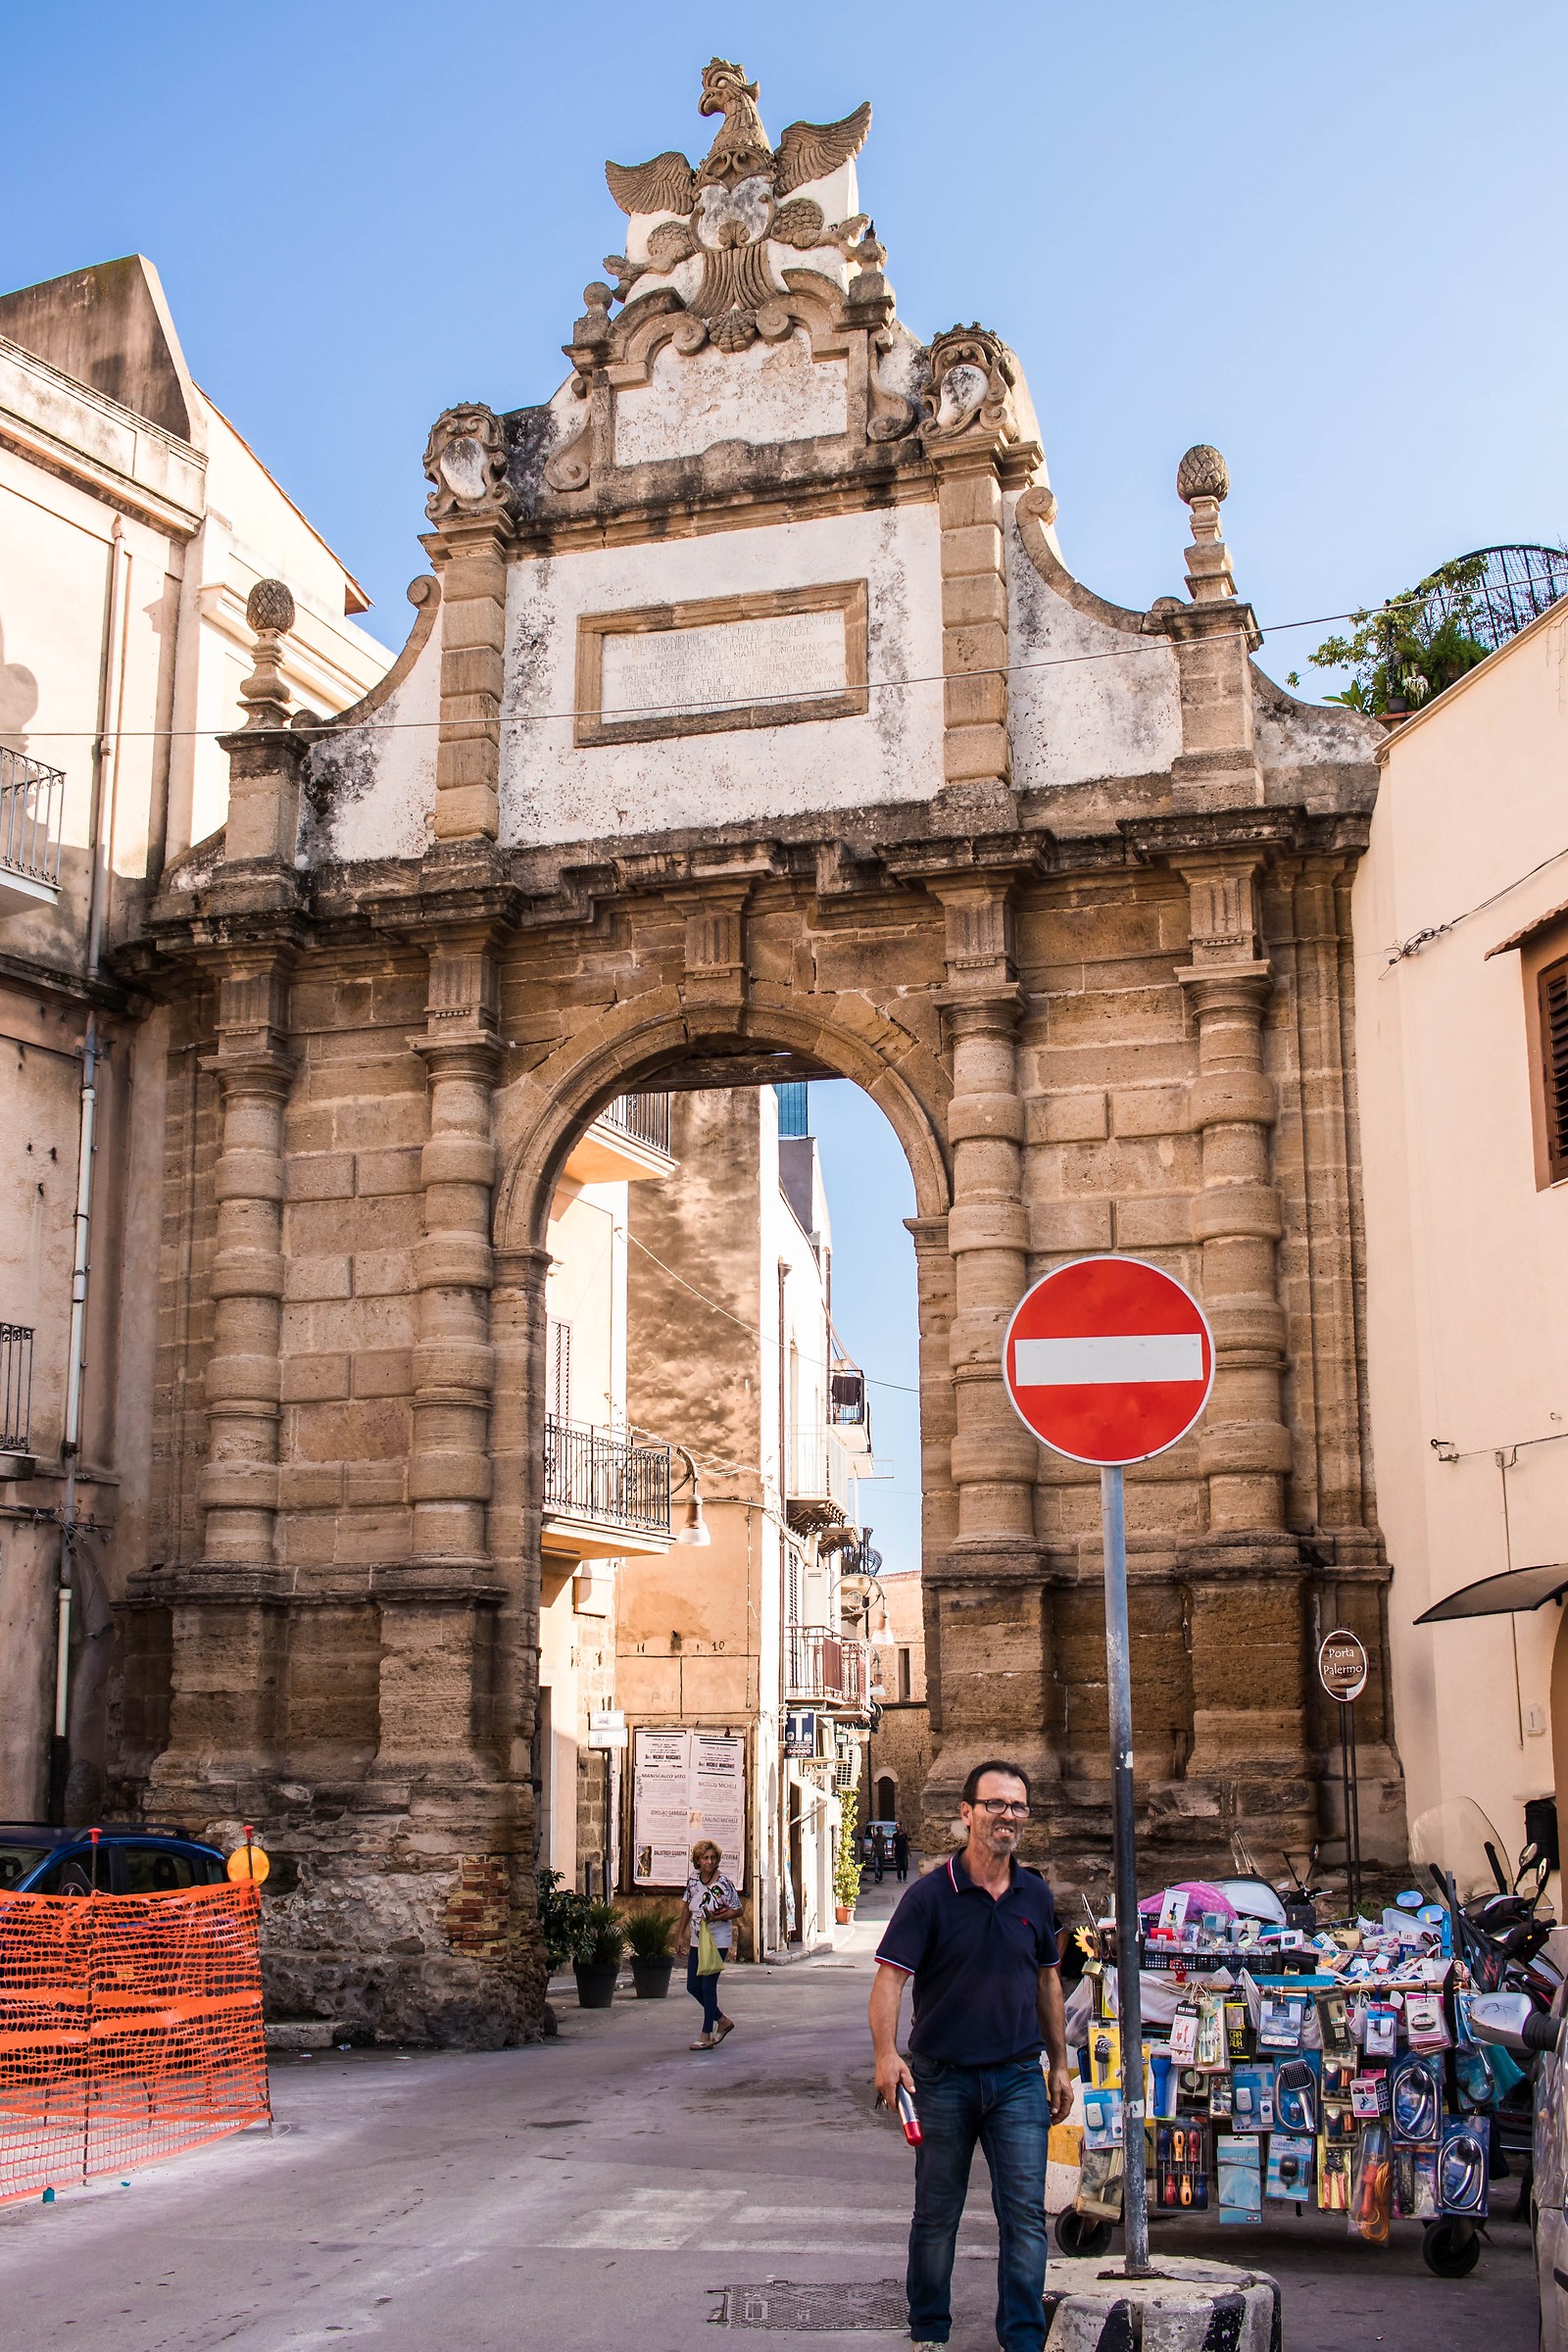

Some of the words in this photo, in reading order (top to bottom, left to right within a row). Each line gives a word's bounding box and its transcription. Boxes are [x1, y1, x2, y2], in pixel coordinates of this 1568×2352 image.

[823, 614, 842, 624] REGE
[698, 653, 728, 663] STELLA
[733, 649, 760, 659] MARIO
[769, 642, 823, 655] BONGIORNO
[790, 657, 827, 668] PORTAM
[621, 669, 656, 681] CAROLO
[625, 686, 650, 696] HANC
[656, 681, 685, 692] PATRES
[709, 683, 736, 694] PRODIT
[1329, 1647, 1354, 1658] Porta
[1323, 1662, 1363, 1676] Palermo
[790, 1713, 808, 1740] T
